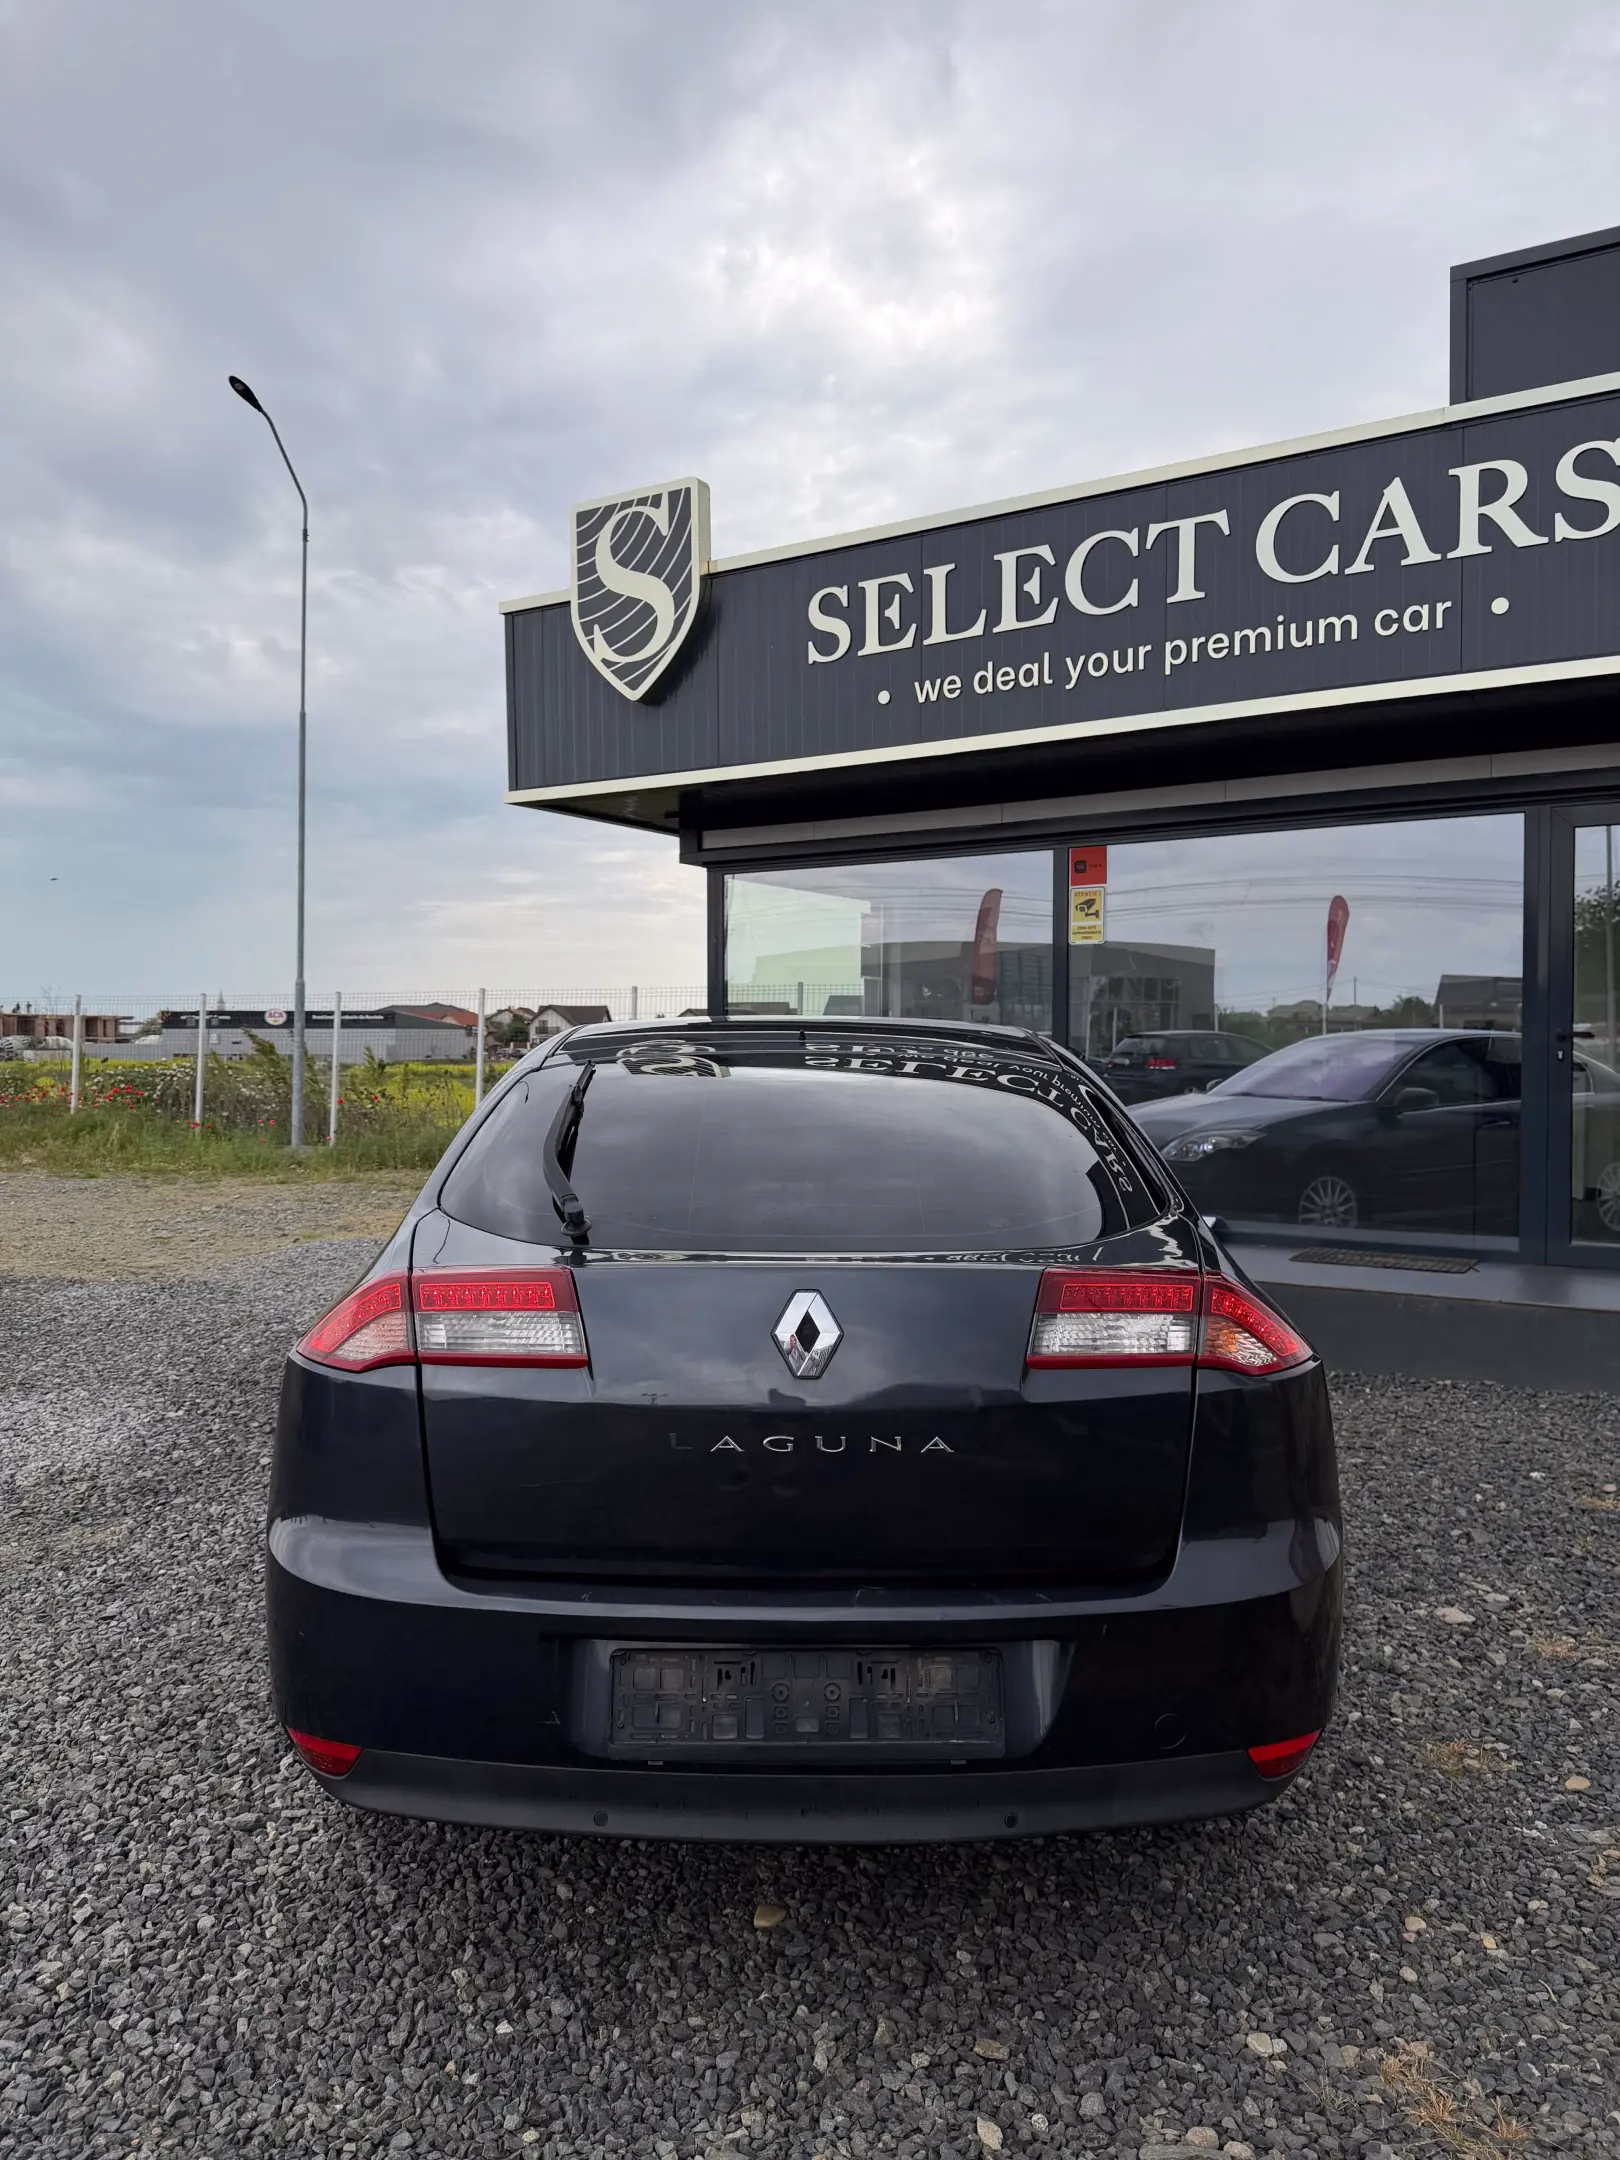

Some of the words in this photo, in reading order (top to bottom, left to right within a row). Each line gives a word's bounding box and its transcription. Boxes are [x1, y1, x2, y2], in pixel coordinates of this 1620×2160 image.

[594, 490, 677, 662] S
[807, 508, 1230, 665] SELECT
[1255, 437, 1620, 583] CARS
[914, 675, 963, 704] we
[973, 652, 1053, 694] deal
[1065, 644, 1152, 690] your
[1164, 614, 1359, 676] premium
[1374, 600, 1453, 637] car
[669, 1432, 954, 1453] LAGUNA
